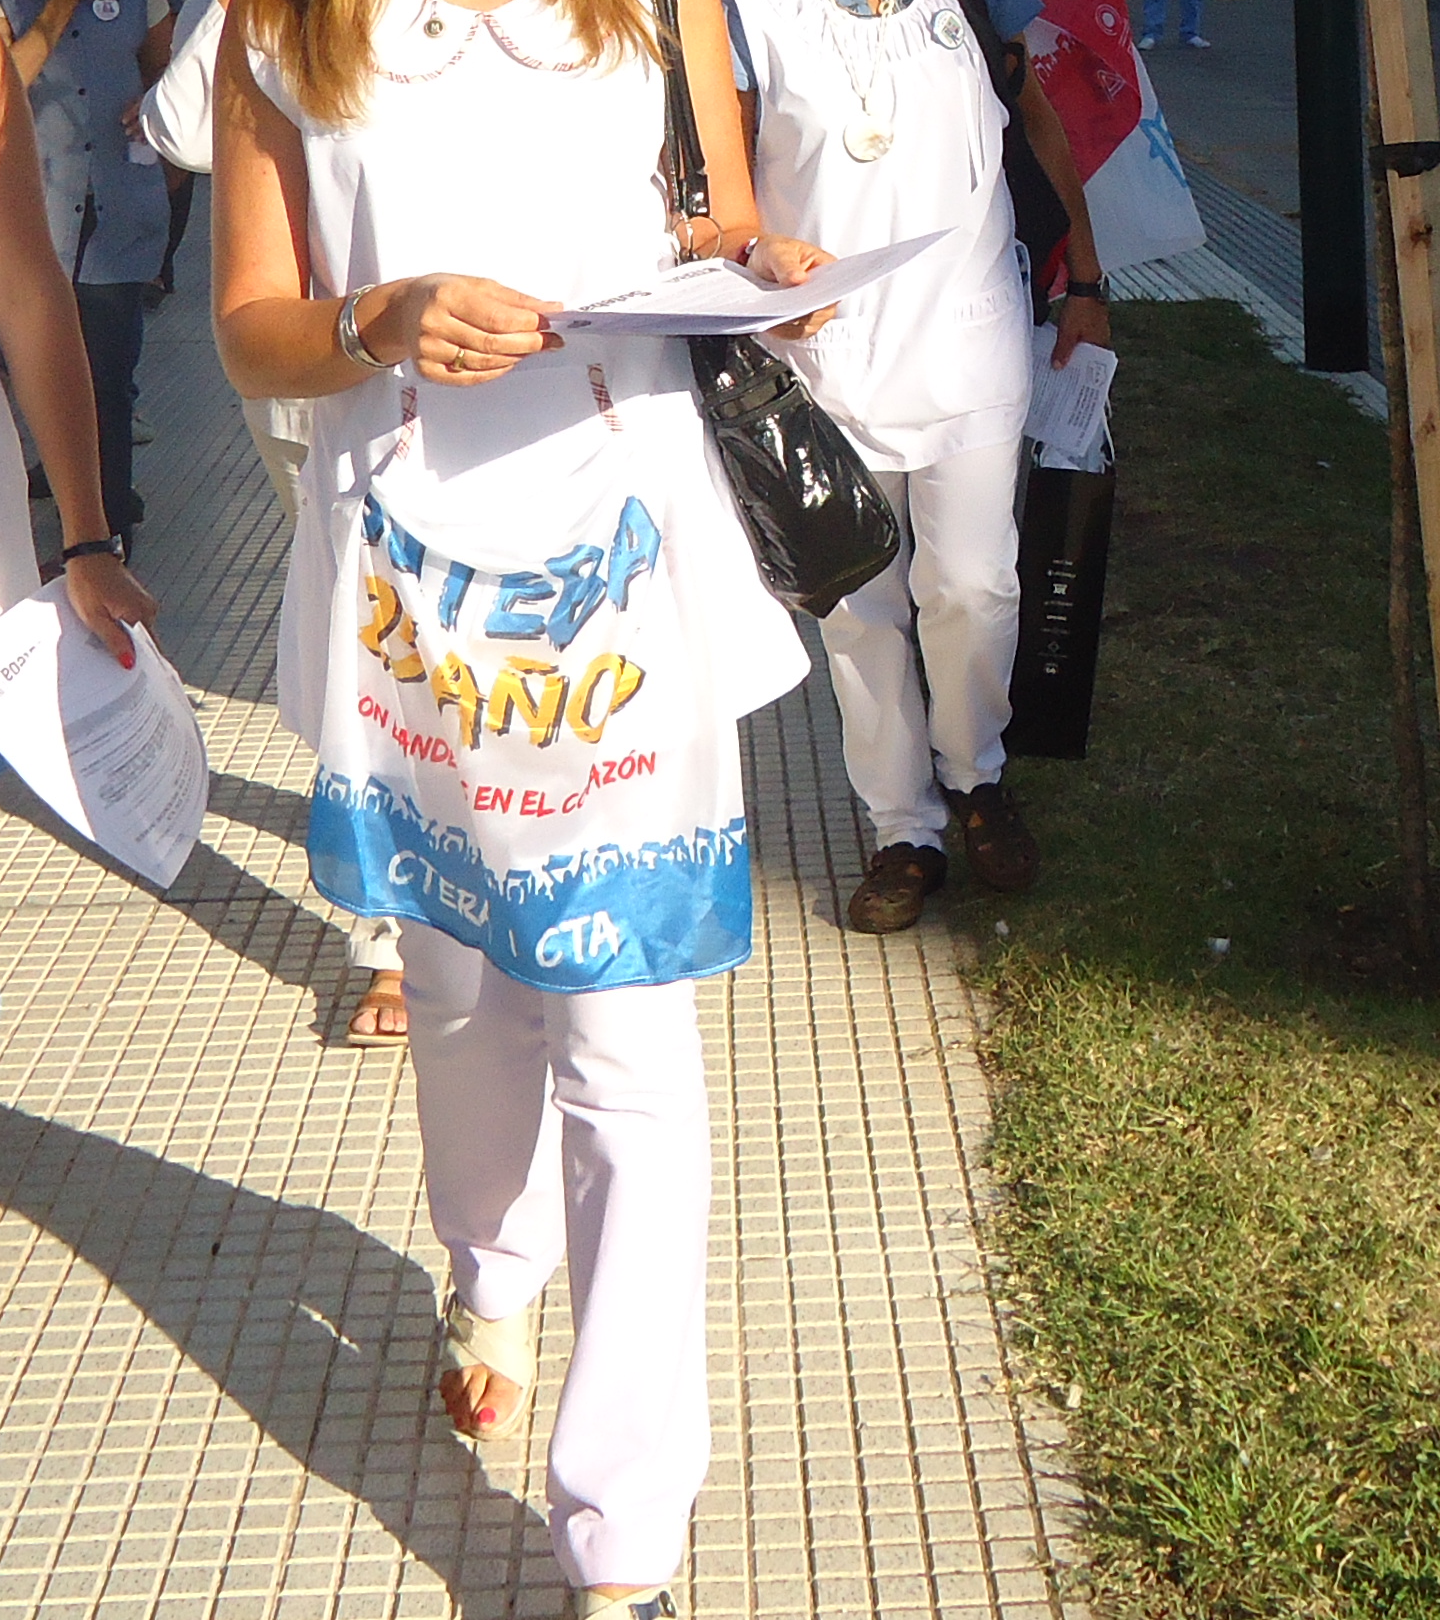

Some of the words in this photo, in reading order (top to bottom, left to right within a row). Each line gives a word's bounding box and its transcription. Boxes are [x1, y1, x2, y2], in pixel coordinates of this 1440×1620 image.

[473, 785, 514, 814] EN
[519, 789, 556, 818] EL
[534, 910, 621, 968] CTA
